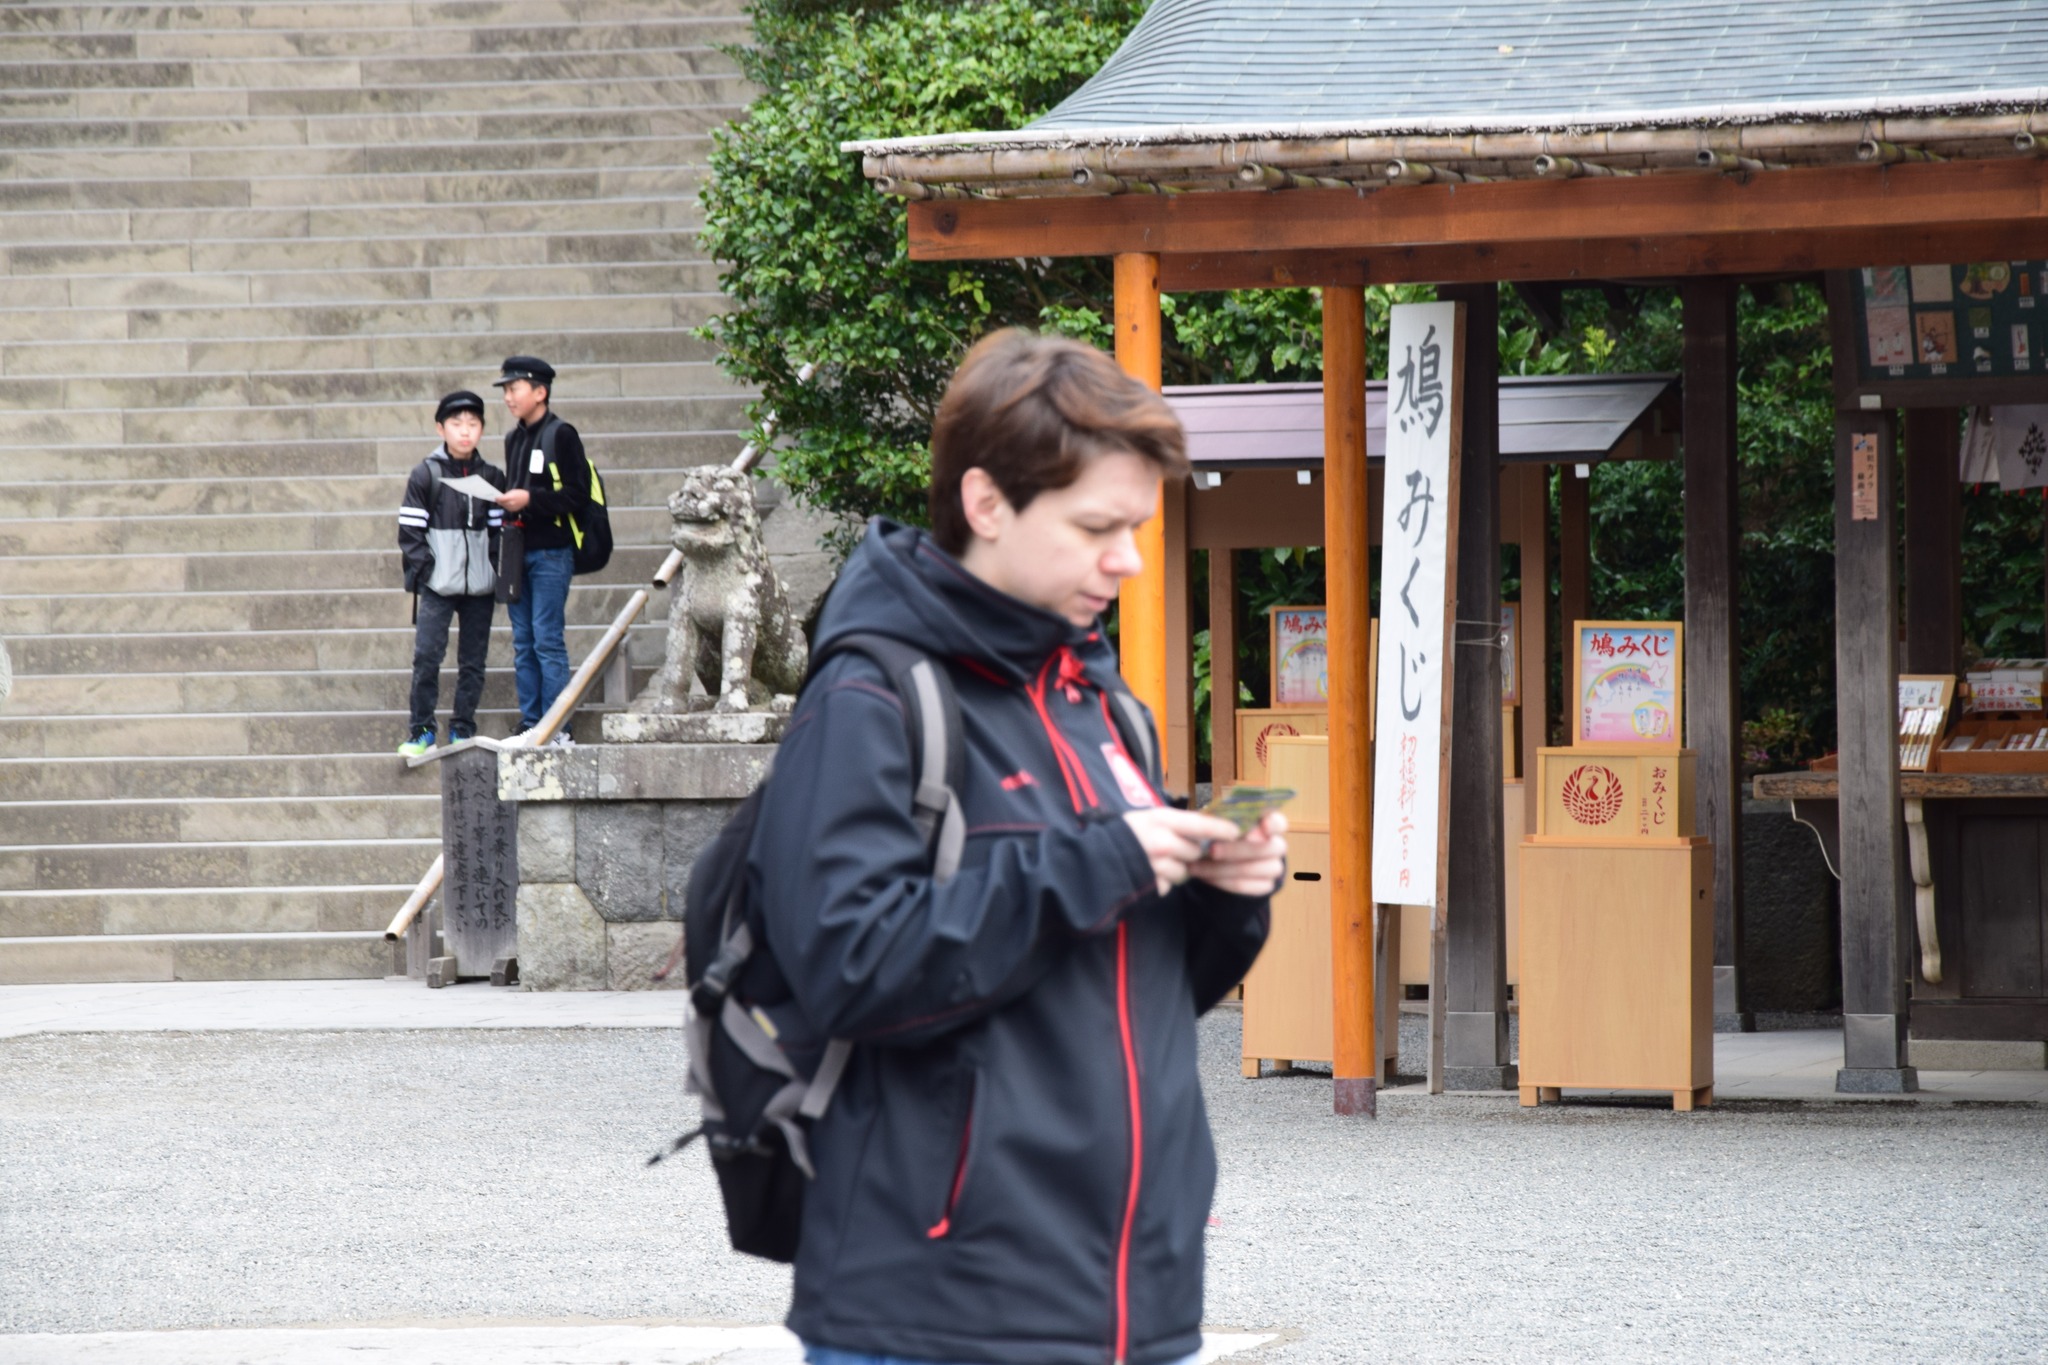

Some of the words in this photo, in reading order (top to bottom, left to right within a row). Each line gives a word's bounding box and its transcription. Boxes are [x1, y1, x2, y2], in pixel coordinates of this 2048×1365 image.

[1393, 324, 1444, 722] 鳩みくじ
[1283, 614, 1328, 635] 鳩み
[1590, 632, 1670, 658] 鳩みくじ
[1651, 766, 1668, 825] おみくじ
